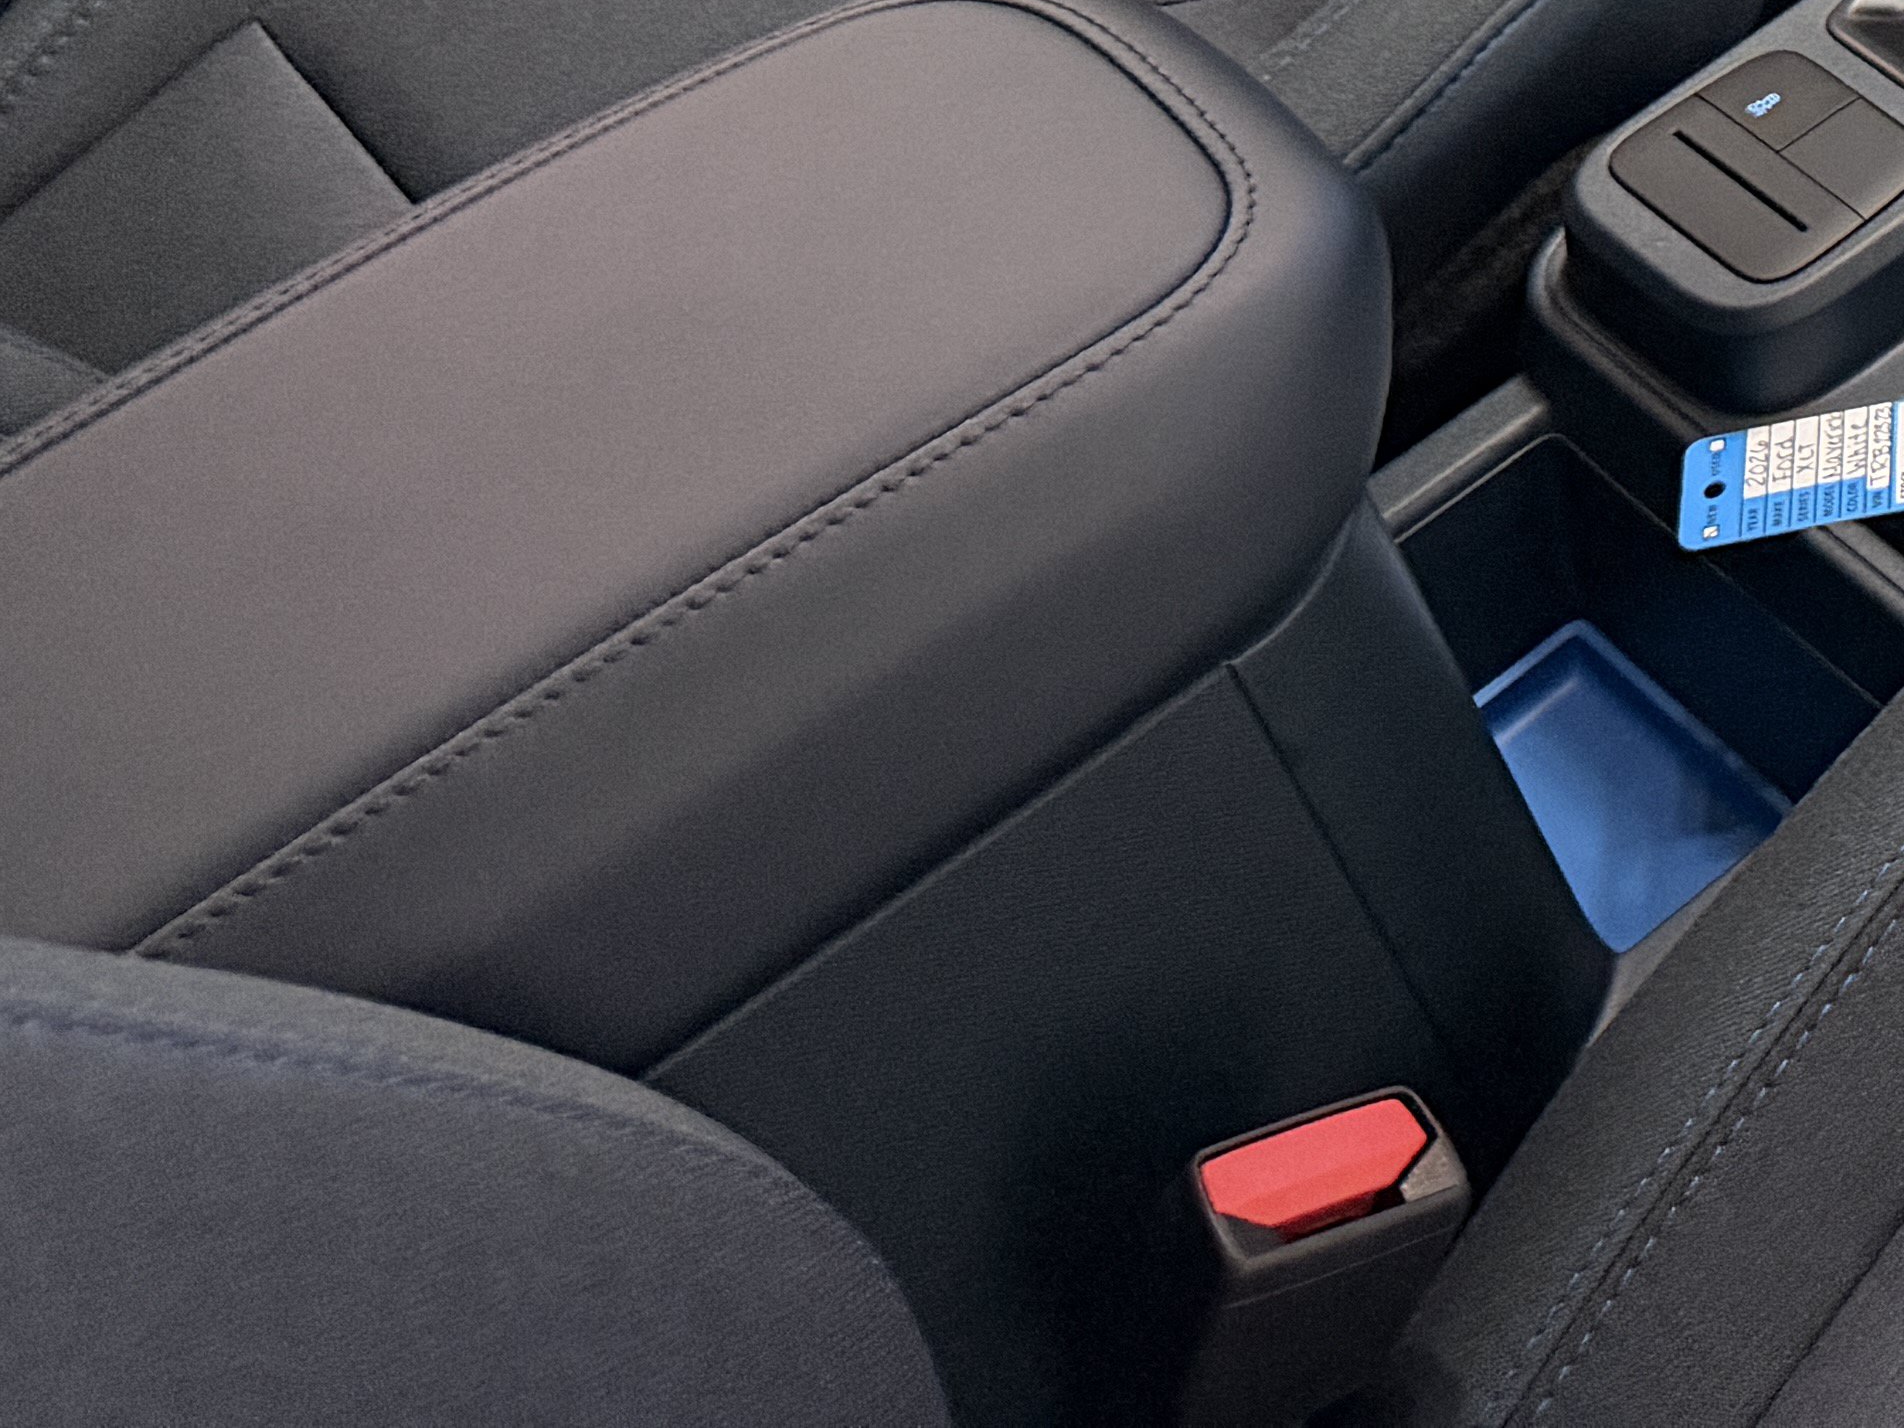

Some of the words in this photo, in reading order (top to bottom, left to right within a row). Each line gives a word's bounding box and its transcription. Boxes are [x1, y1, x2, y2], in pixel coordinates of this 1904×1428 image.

[1746, 440, 1768, 487] 2026
[1772, 437, 1794, 484] Ford
[1796, 443, 1814, 475] XLT
[1846, 421, 1868, 477] White
[1822, 481, 1835, 518] MODEL
[1846, 480, 1859, 514] COLOR
